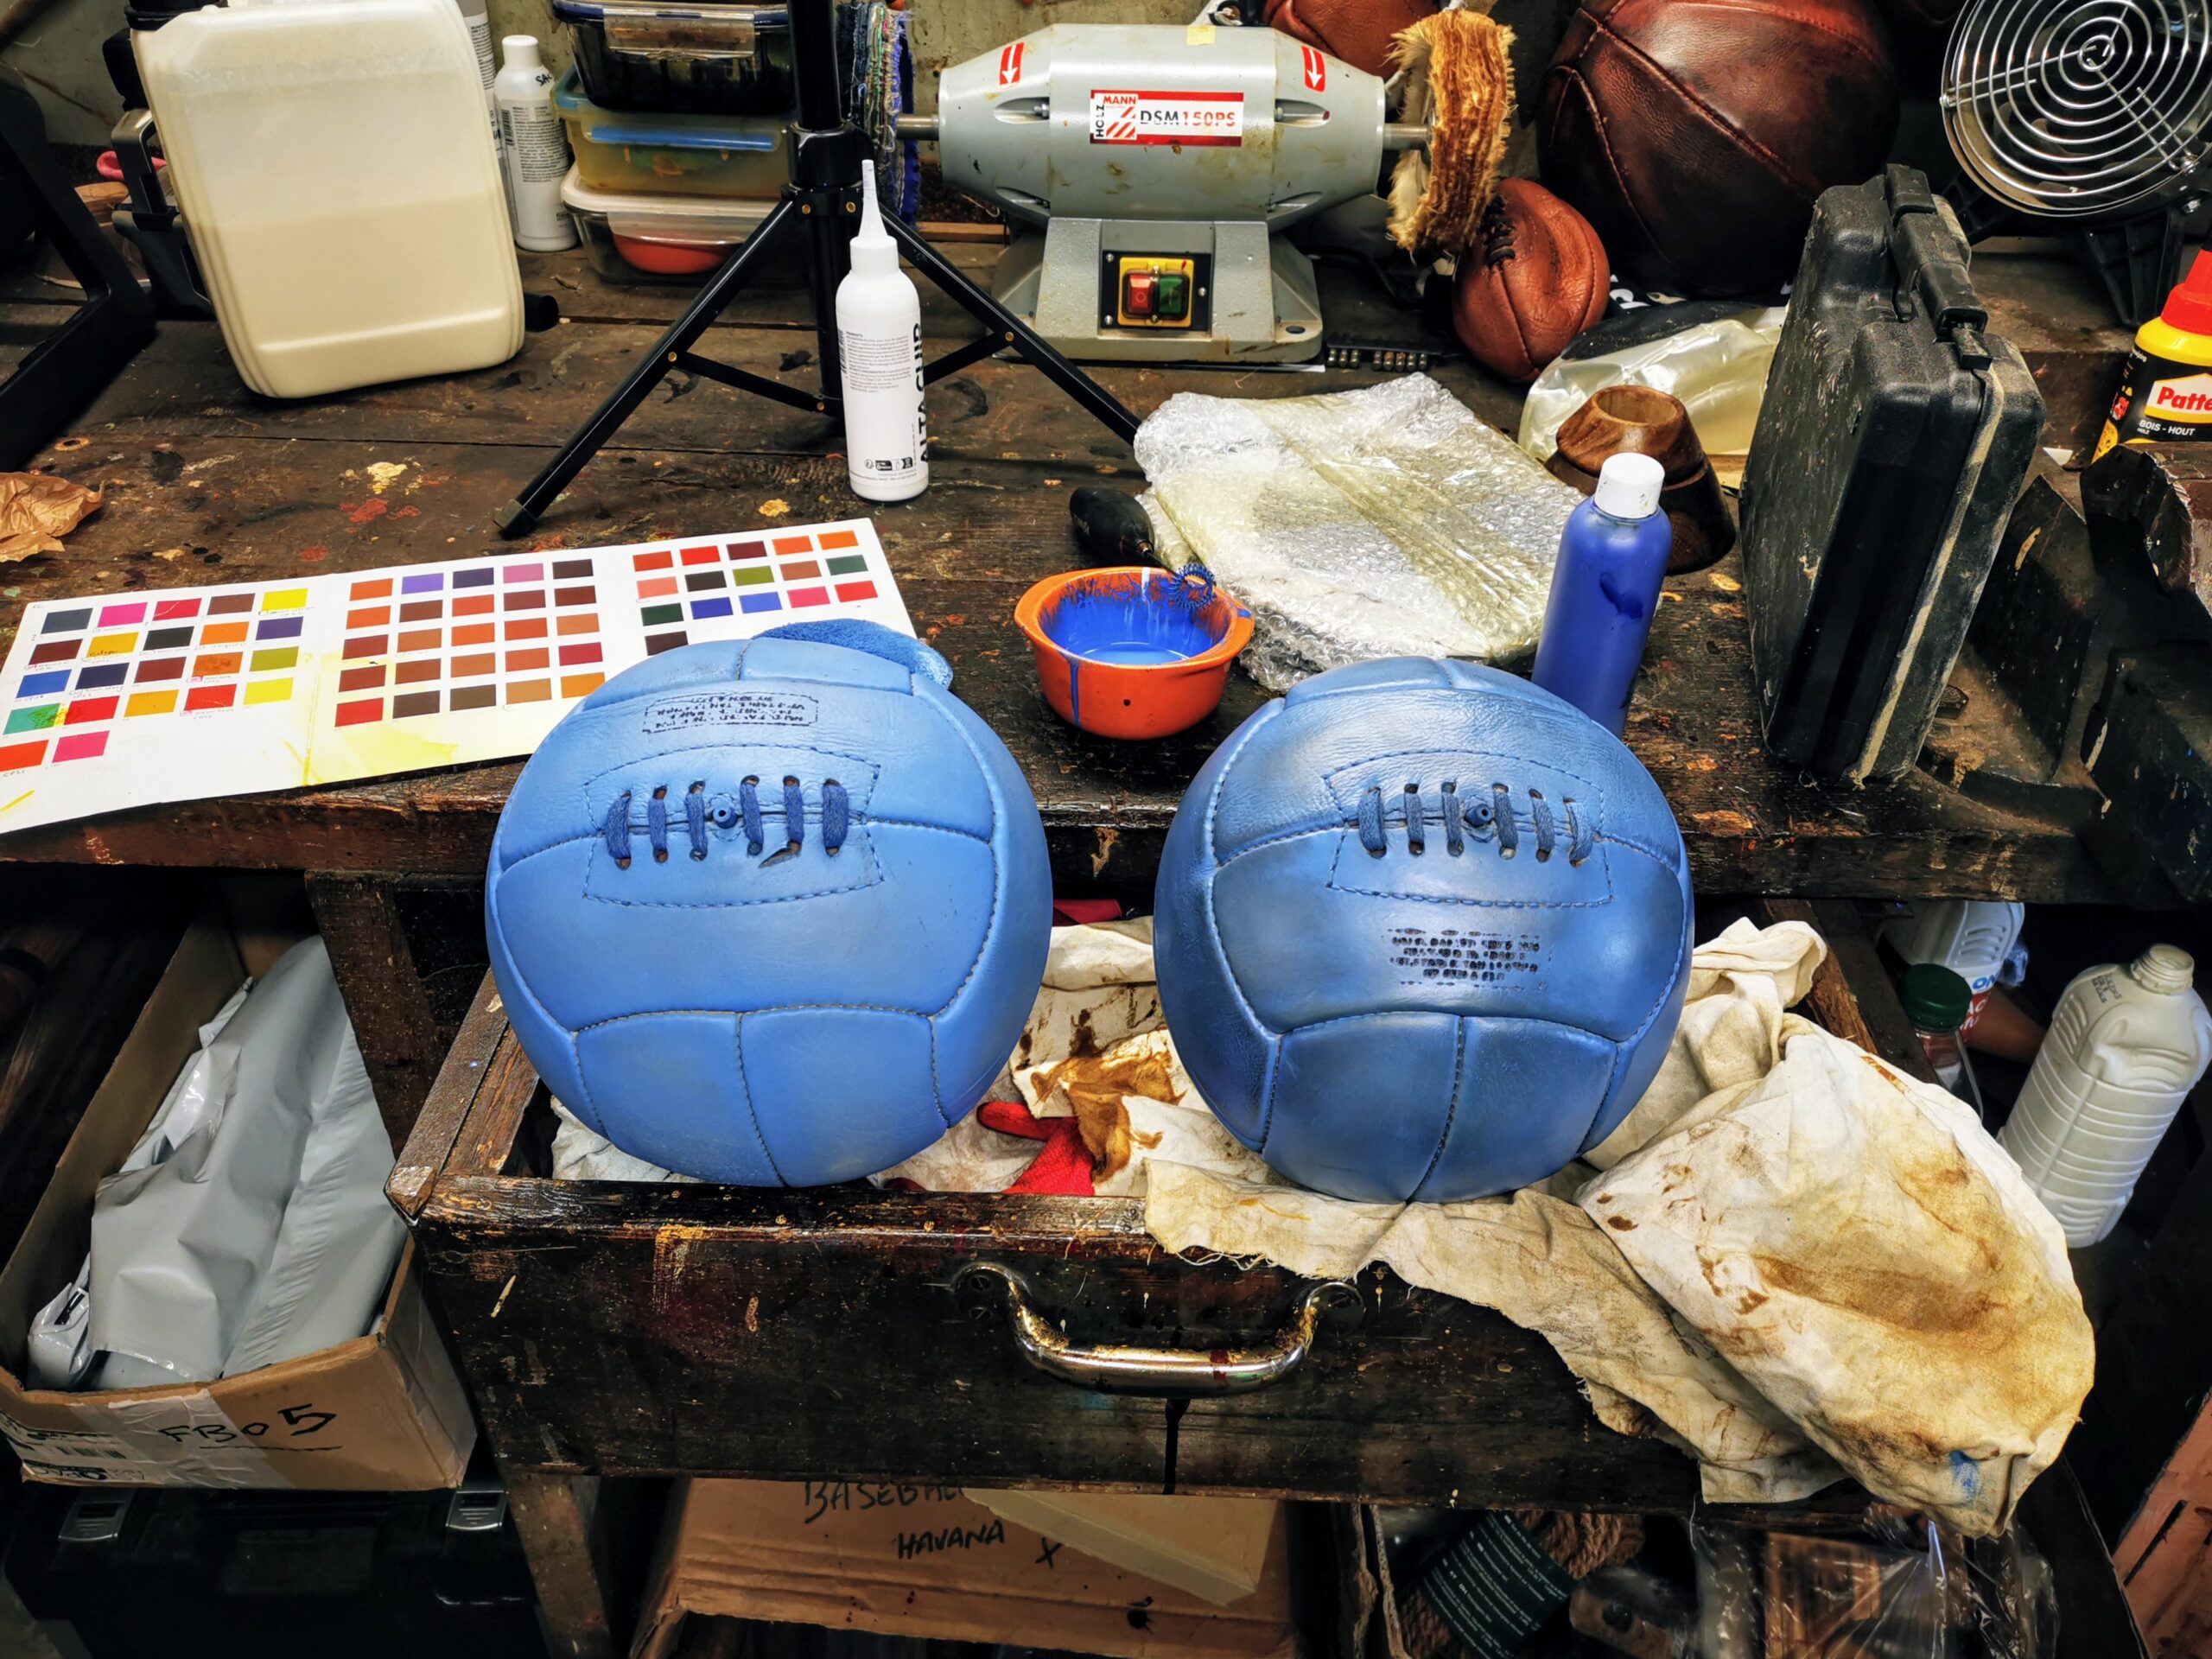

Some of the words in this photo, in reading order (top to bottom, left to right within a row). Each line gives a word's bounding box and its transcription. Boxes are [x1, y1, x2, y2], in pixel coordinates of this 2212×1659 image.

[1096, 105, 1104, 137] HOLZ
[1103, 95, 1136, 105] MANN
[2139, 419, 2161, 431] BOIS
[2167, 426, 2196, 436] HOUT
[895, 1519, 1005, 1560] HAVANA
